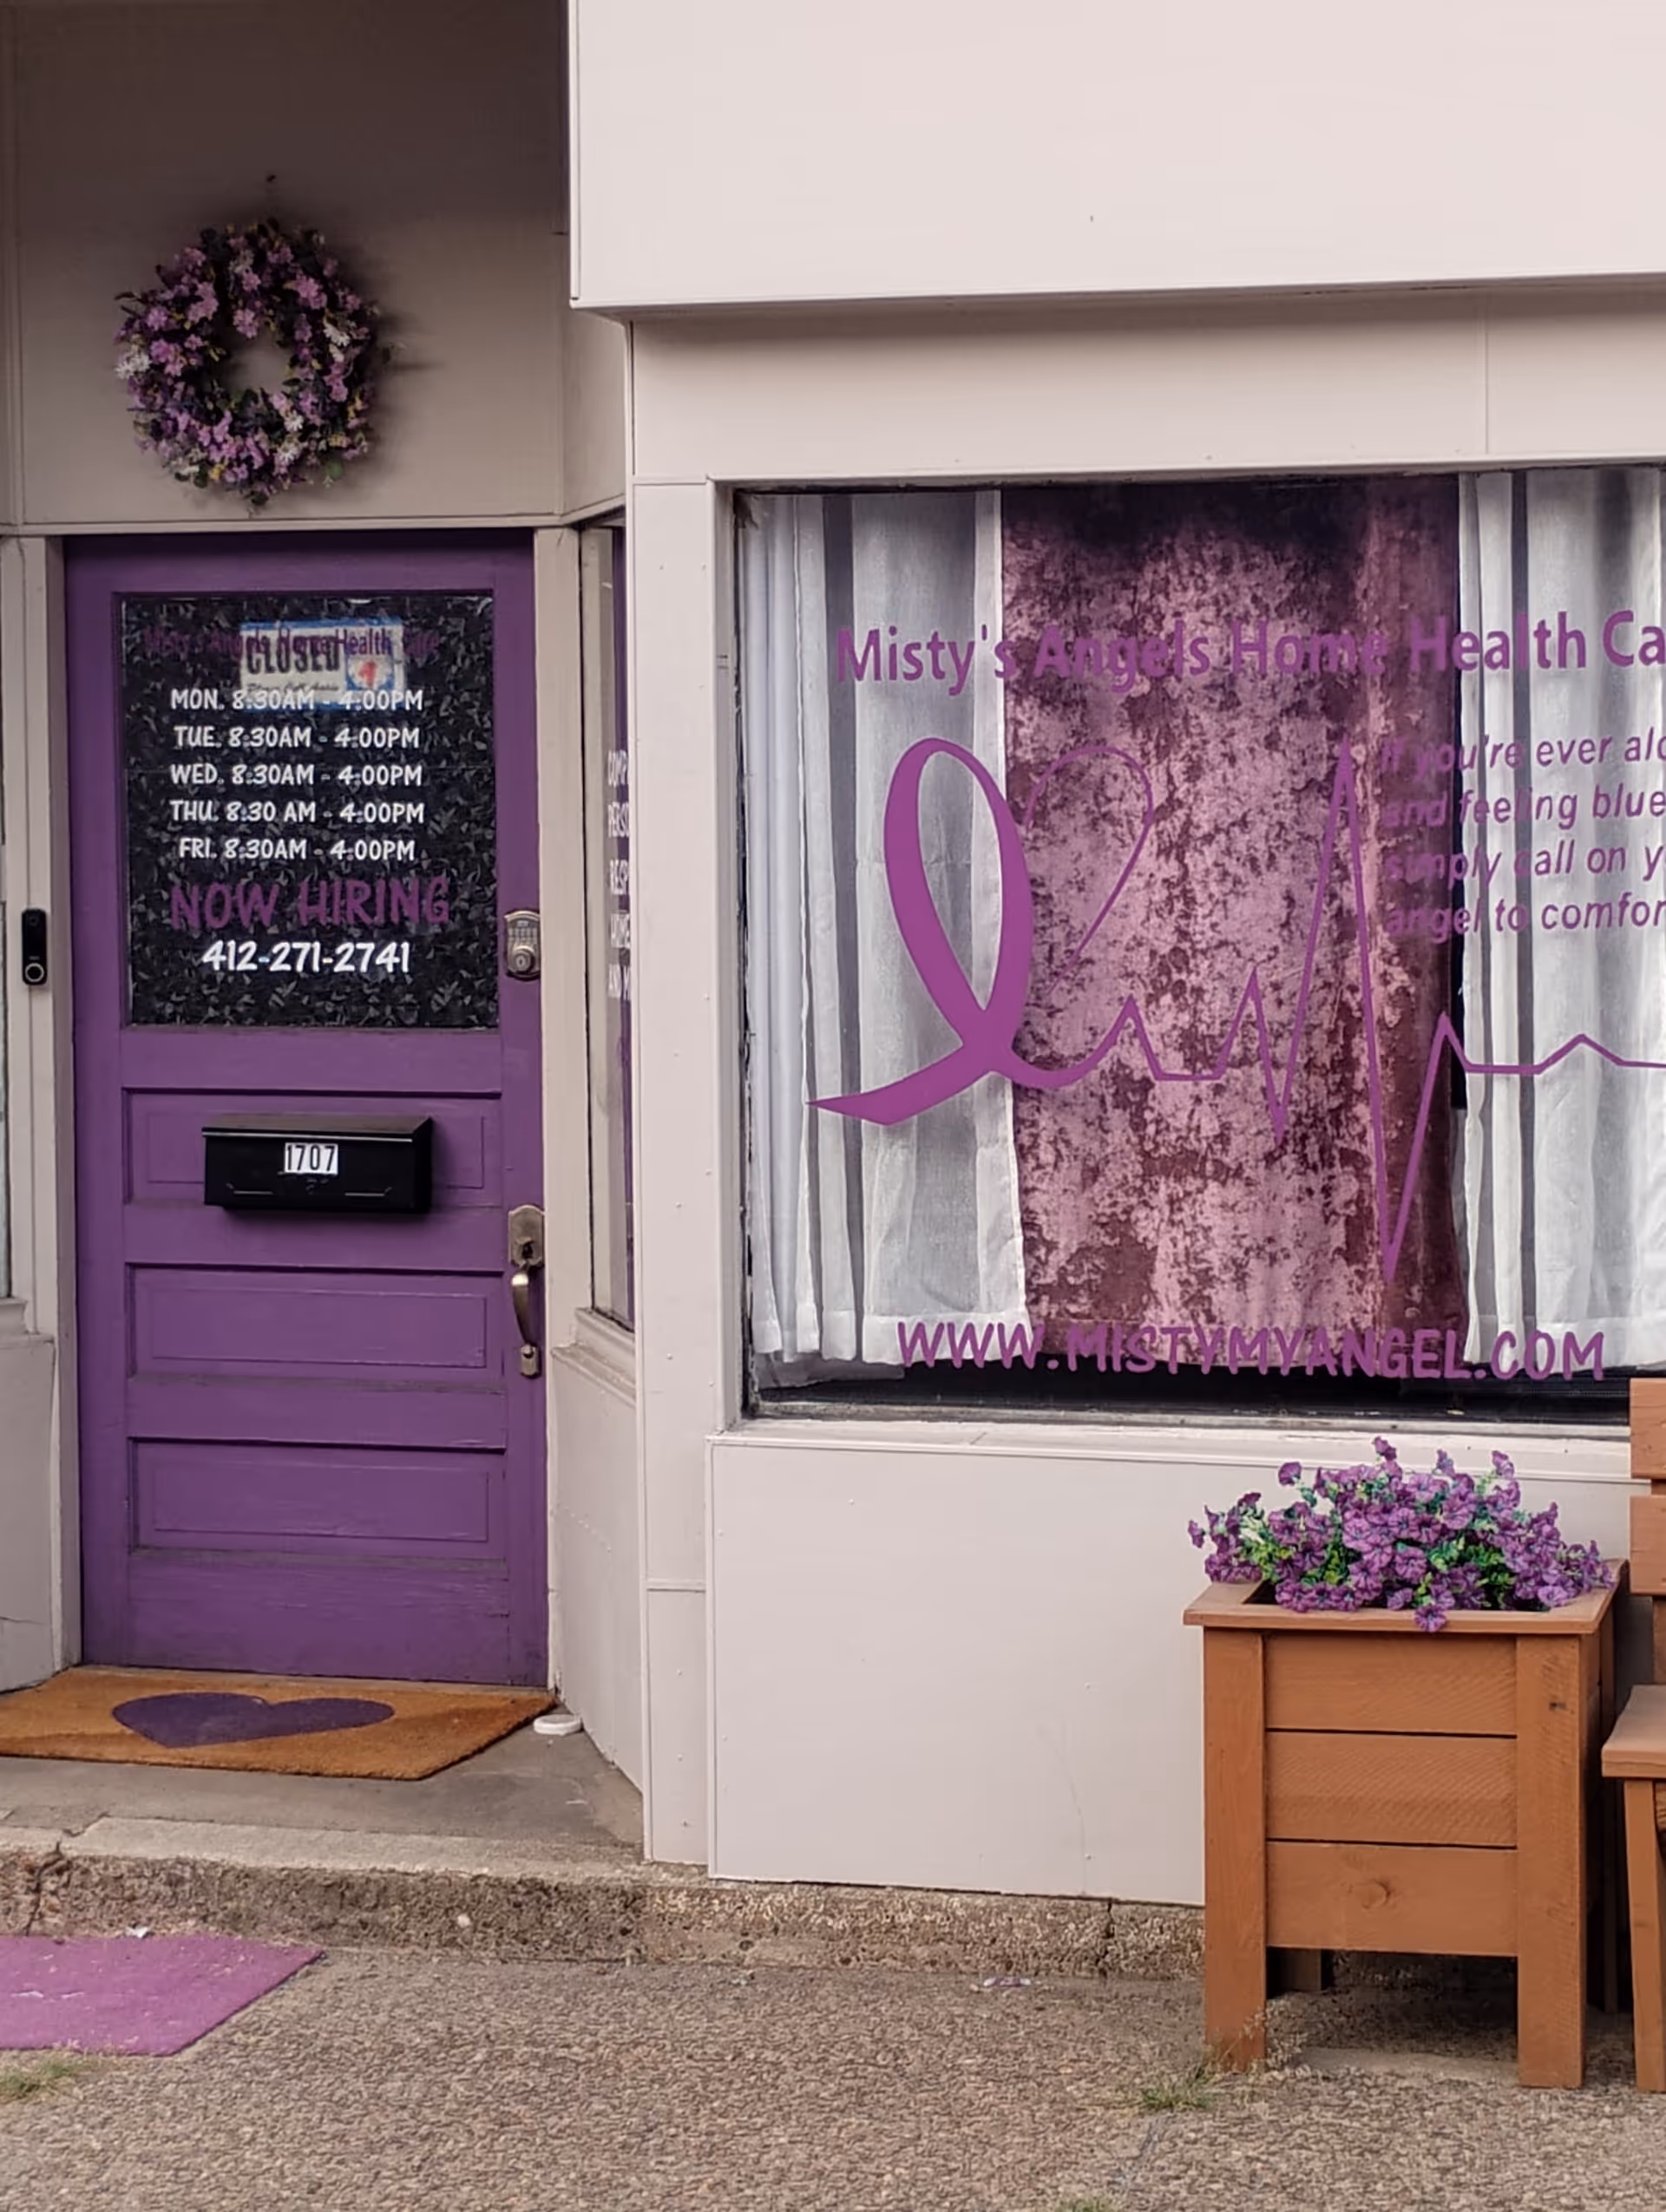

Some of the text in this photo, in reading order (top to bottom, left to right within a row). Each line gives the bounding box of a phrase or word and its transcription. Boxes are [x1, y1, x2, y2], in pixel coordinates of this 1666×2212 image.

[246, 636, 340, 675] CLOSED
[336, 628, 391, 656] Health
[836, 610, 1666, 696] Misty's Angels Home Health Ca
[171, 688, 225, 710] MON.
[232, 689, 314, 710] 8:30AM
[338, 690, 423, 710] 4:00PM
[174, 726, 222, 748] TUE.
[228, 726, 312, 748] 8:30AM
[334, 727, 419, 749] 4:00PM
[171, 763, 225, 784] WED.
[232, 764, 315, 786] 8:30AM
[338, 764, 423, 786] 4:00PM
[1413, 734, 1523, 783] you're
[1537, 737, 1612, 767] ever
[169, 800, 220, 821] THU.
[226, 801, 276, 821] 8:30
[284, 801, 316, 823] AM
[339, 802, 424, 824] 4:00PM
[1381, 782, 1666, 830] and feeling blue
[179, 837, 217, 859] FRI.
[225, 837, 307, 860] 8:30AM
[330, 839, 415, 861] 4:00PM
[1386, 843, 1502, 890] simply
[1514, 839, 1575, 876] call
[1587, 846, 1626, 874] on
[170, 876, 449, 929] NOW HIRING
[1386, 897, 1482, 945] angel
[1496, 899, 1529, 932] to
[202, 939, 410, 972] 412-271-2741
[287, 1144, 336, 1171] 1707
[897, 1321, 1605, 1381] WWW.MISTYMYANGEL.COM
